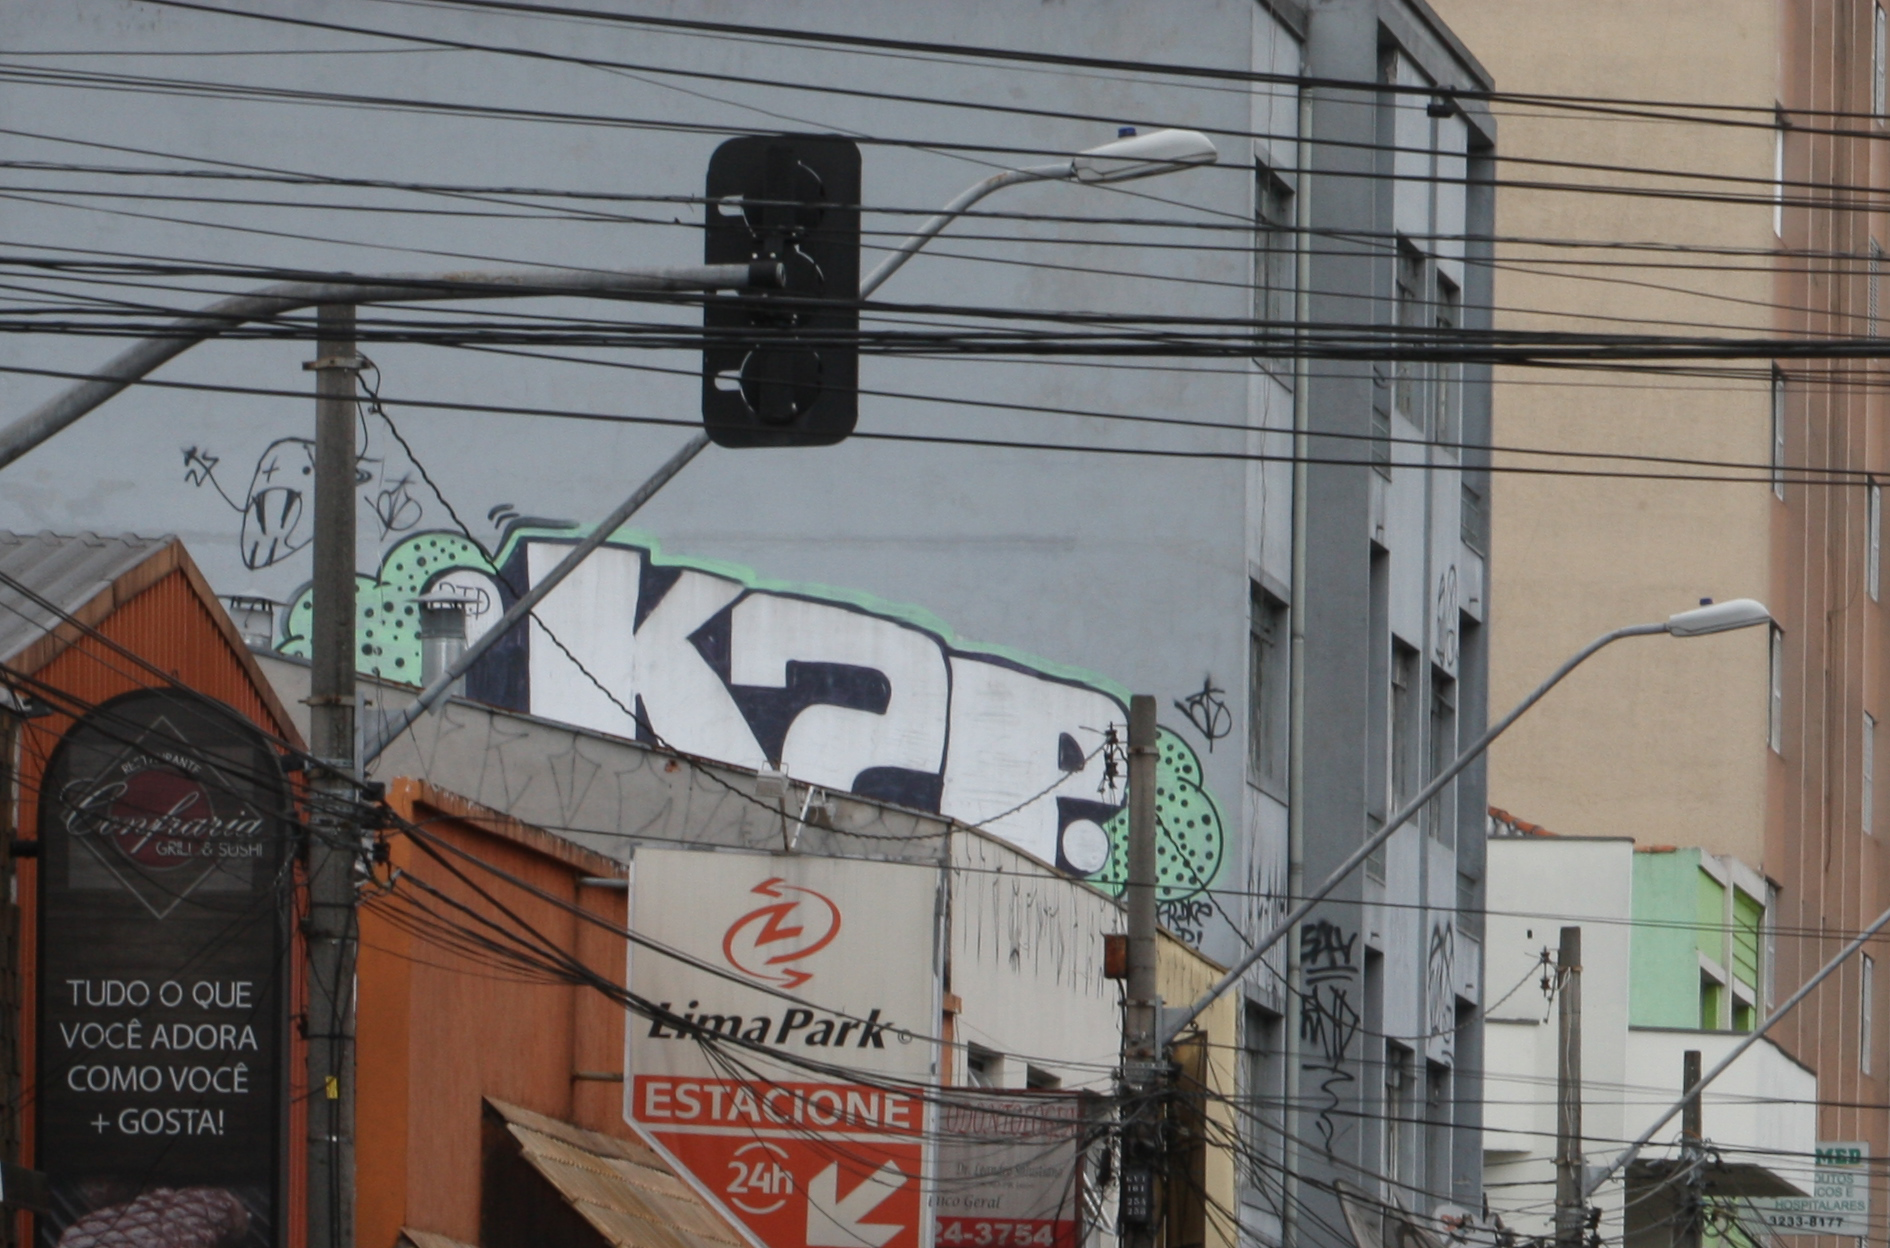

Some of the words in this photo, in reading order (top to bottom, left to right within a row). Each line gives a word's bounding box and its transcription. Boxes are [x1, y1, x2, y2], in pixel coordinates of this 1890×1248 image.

[60, 777, 263, 855] Confraria
[219, 843, 263, 858] SUSHI
[66, 979, 150, 1006] TUDO
[159, 981, 183, 1007] O
[192, 981, 253, 1009] QUE
[59, 1018, 143, 1049] VOCÊ
[150, 1024, 258, 1050] ADORA
[67, 1065, 163, 1092] COMO
[168, 1062, 249, 1093] VOCÊ
[645, 1081, 910, 1128] ESTACIONE
[91, 1113, 110, 1134] +
[118, 1108, 224, 1135] GOSTA!
[727, 1160, 794, 1195] 24h
[1775, 1200, 1866, 1211] HOSPITALARES
[1769, 1216, 1844, 1227] 3233-8177
